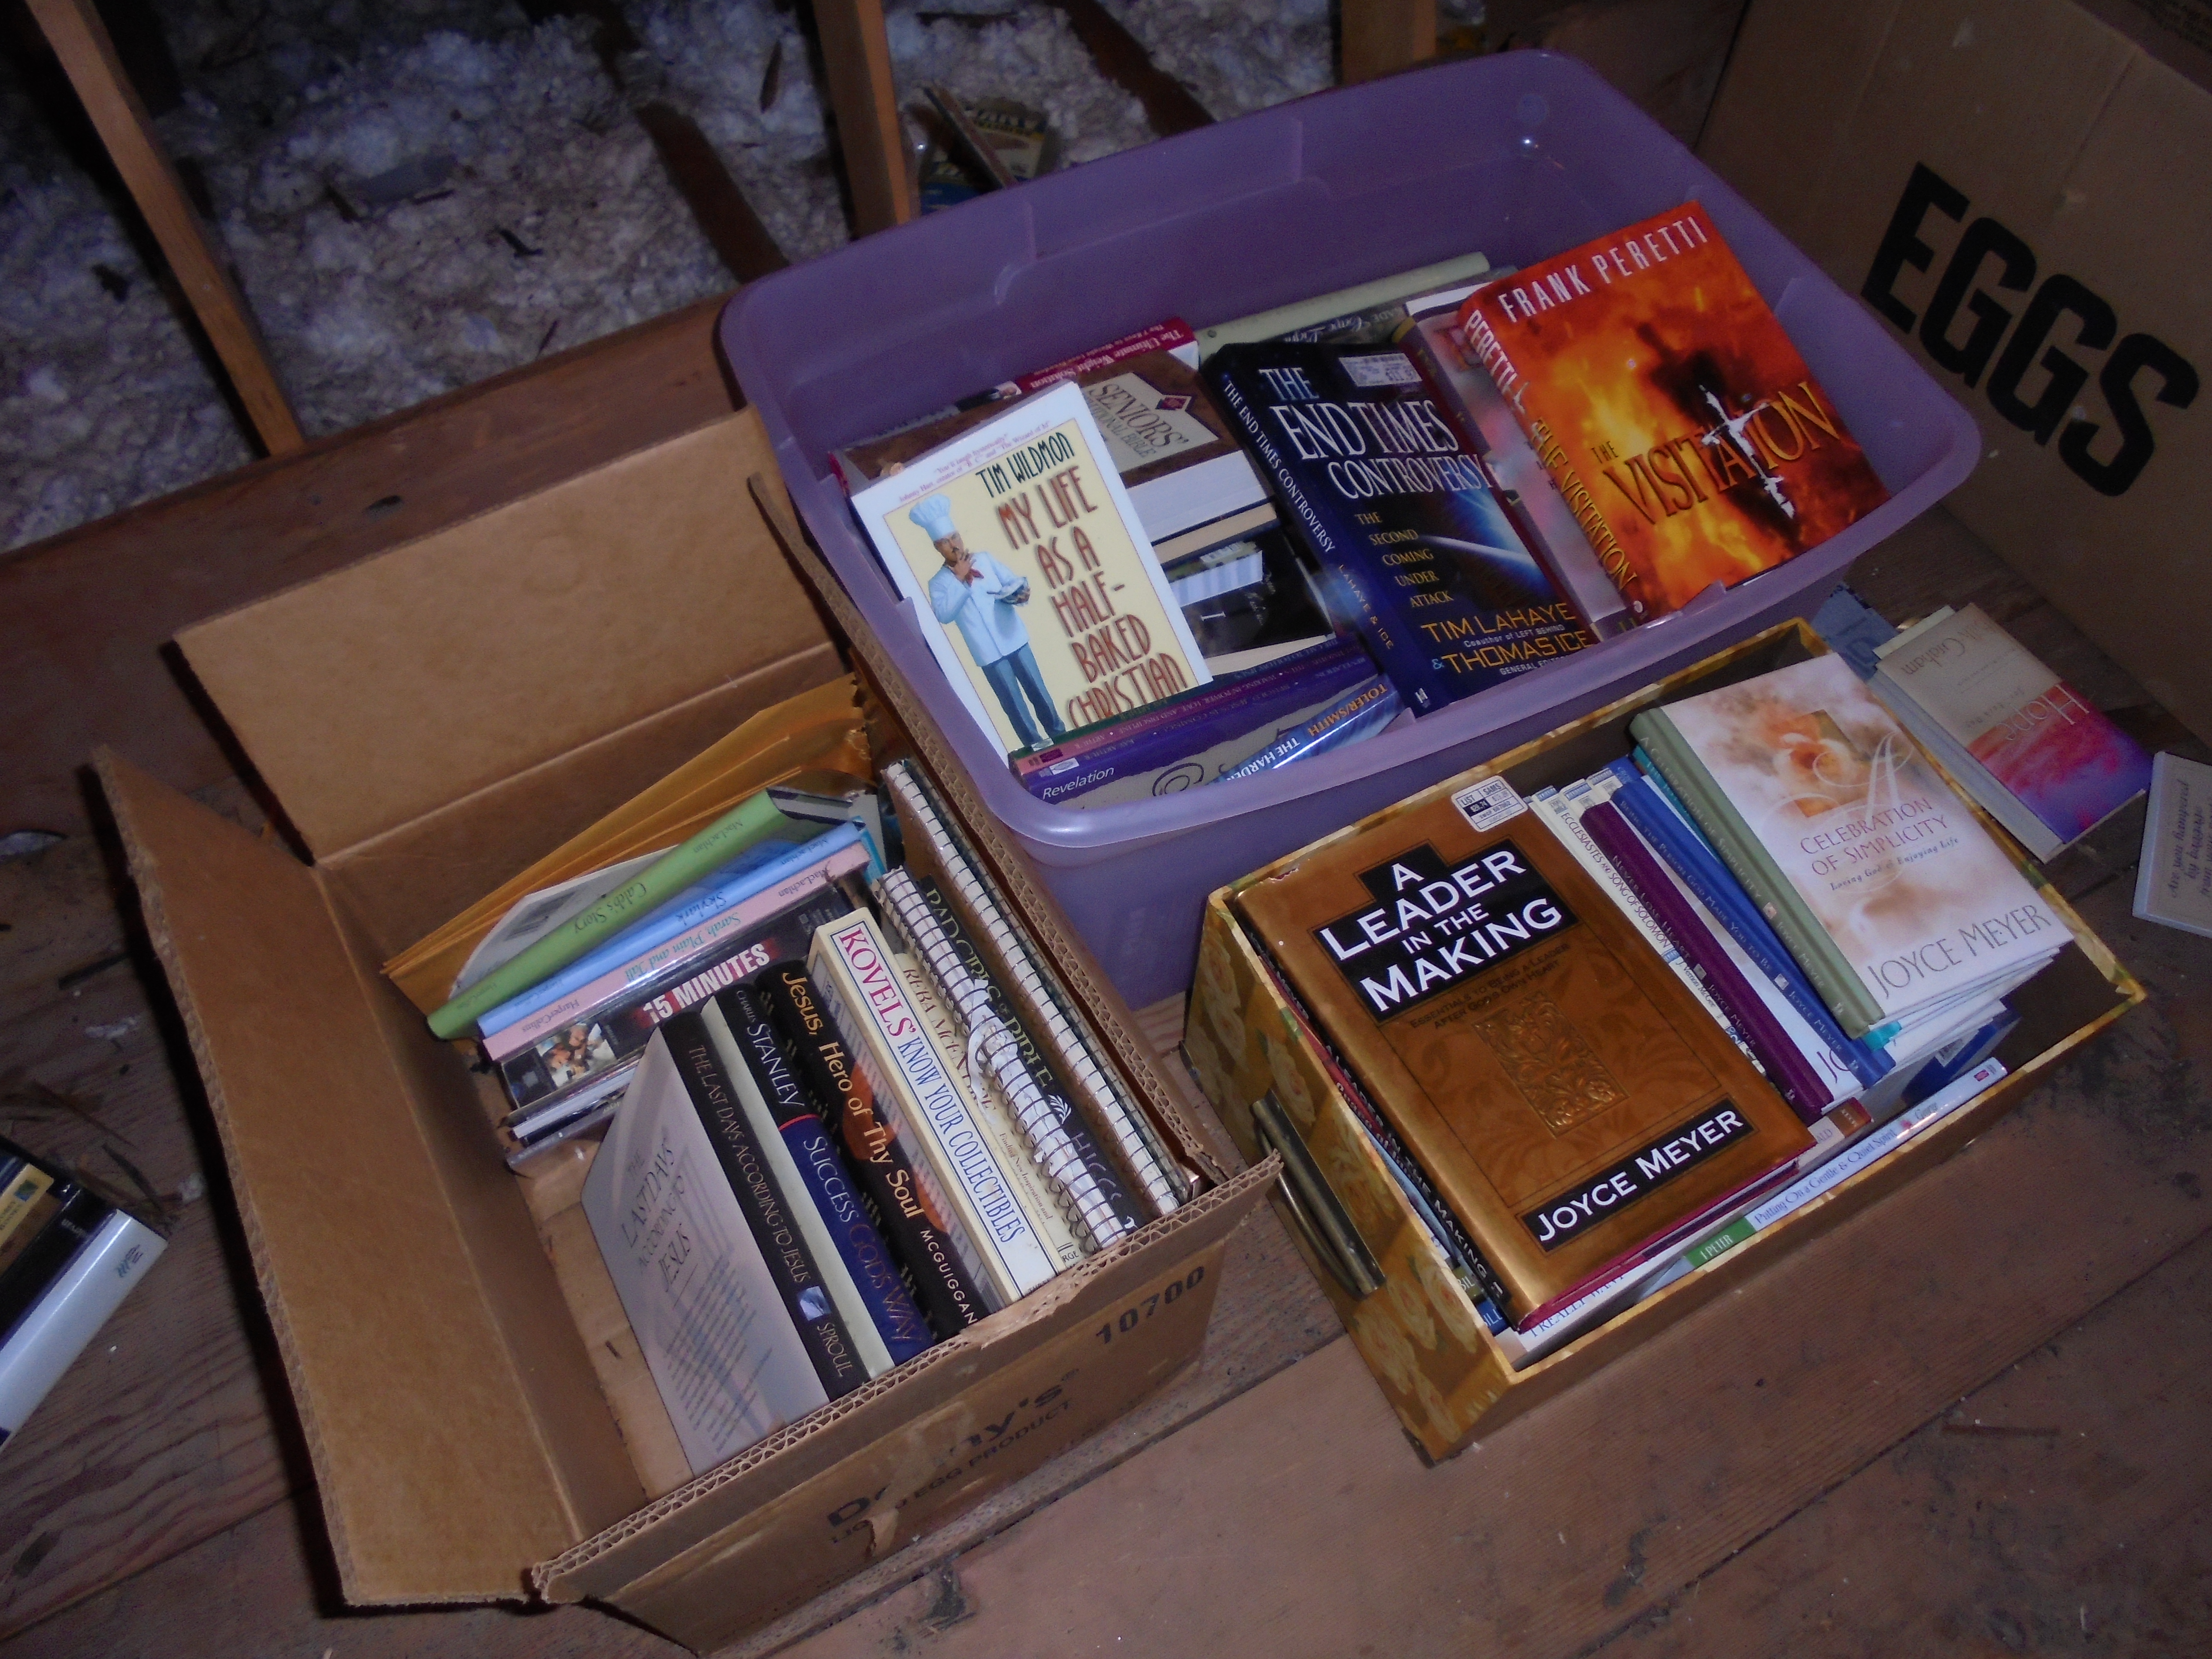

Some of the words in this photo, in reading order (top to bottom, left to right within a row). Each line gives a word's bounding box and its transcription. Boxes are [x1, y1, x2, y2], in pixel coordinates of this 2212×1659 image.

[1498, 265, 1590, 323] FRANK
[1592, 216, 1707, 284] PERETTI
[1114, 337, 1160, 357] Ultimate
[1161, 330, 1184, 340] The
[1464, 310, 1518, 394] PERETTI
[1861, 161, 2200, 497] EGGS
[1031, 369, 1076, 388] Solution
[1078, 355, 1115, 372] Weight
[1258, 367, 1319, 401] THE
[1121, 433, 1157, 458] BIBLE
[1270, 402, 1366, 459] END
[1347, 400, 1458, 453] TIMES
[1591, 441, 1620, 465] THE
[1603, 381, 1840, 525] VISITATION
[976, 468, 1012, 498] TIM
[1006, 432, 1075, 483] WILDMON
[1328, 454, 1493, 499] CONTROVERSY
[996, 493, 1041, 549] MY
[1038, 466, 1097, 528] LIFE
[1223, 381, 1241, 408] THE
[1240, 405, 1259, 434] END
[1256, 431, 1282, 469] TIMES
[1279, 468, 1335, 553] CONTROVERSY
[1338, 564, 1371, 613] LAHAYE
[1378, 628, 1393, 649] ICE
[1355, 512, 1382, 526] THE
[1561, 471, 1638, 590] VISITATION
[1037, 537, 1074, 589] AS
[1073, 527, 1100, 571] A
[1369, 529, 1419, 546] SECOND
[1382, 548, 1434, 566] COMING
[1394, 570, 1439, 586] UNDER
[1410, 590, 1454, 608] ATTACK
[1051, 571, 1125, 637] HALF-
[1421, 620, 1476, 642] TIM
[1474, 603, 1577, 633] LAHAYE
[1072, 615, 1151, 683] BAKED
[1431, 658, 1444, 670] &
[1441, 636, 1554, 673] THOMAS
[1556, 631, 1594, 649] ICE
[1464, 635, 1502, 648] Coauthor
[1505, 632, 1513, 640] of
[1514, 628, 1535, 639] LEFT
[1537, 624, 1565, 635] BEHIND
[1068, 653, 1188, 728] CHRISTIAN
[1499, 663, 1537, 675] GENERAL
[1308, 684, 1388, 736] TOLER/SMITH
[1996, 684, 2089, 740] Hope
[1279, 737, 1300, 757] THE
[1042, 766, 1115, 800] Revelation
[1461, 795, 1475, 805] LIST
[1483, 783, 1502, 795] SAMS
[693, 818, 744, 854] MacLachlan
[1799, 796, 1934, 855] CELEBRATION
[1811, 855, 1838, 876] OF
[1845, 814, 1949, 865] SIMPLICITY
[778, 867, 830, 898] MacLachlan
[1392, 863, 1425, 891] A
[1830, 872, 1863, 892] Loving
[1864, 864, 1881, 878] God
[1896, 847, 1937, 867] Enjoying
[1941, 836, 1959, 849] Life
[573, 909, 607, 934] Story
[606, 882, 647, 914] Caleb's
[675, 892, 727, 925] Skylark
[1320, 850, 1527, 961] LEADER
[1561, 812, 1603, 863] ECCLESIASTES
[1601, 862, 1611, 873] AND
[1608, 872, 1629, 896] SONG
[1627, 895, 1638, 910] OF
[1634, 904, 1671, 948] SOLOMON
[1682, 964, 1700, 988] Vernon
[1698, 986, 1717, 1008] McGee
[672, 935, 705, 955] Plain
[706, 912, 741, 938] Sarah,
[1401, 931, 1432, 954] IN
[1434, 903, 1490, 936] THE
[625, 963, 645, 982] Tall
[648, 951, 670, 972] and
[1359, 897, 1562, 1012] MAKING
[1867, 938, 1962, 999] JOYCE
[1958, 903, 2052, 956] MEYER
[643, 990, 675, 1025] 15
[673, 942, 770, 1011] MINUTES
[903, 968, 936, 1014] REBA
[1410, 994, 1472, 1028] ESSENTIALS
[1474, 987, 1487, 996] TO
[1489, 969, 1521, 988] BEING
[1529, 943, 1571, 967] LEADER
[1434, 1009, 1468, 1029] AFTER
[1502, 978, 1527, 994] OWN
[1527, 959, 1561, 981] HEART
[521, 999, 580, 1032] HarperCollins
[689, 1044, 709, 1073] THE
[747, 1023, 805, 1107] STANLEY
[702, 1070, 726, 1106] LAST
[838, 927, 917, 1038] KOVELS'
[896, 1036, 943, 1087] KNOW
[923, 1084, 964, 1135] YOUR
[948, 1130, 1027, 1243] COLLECTIBLES
[717, 1103, 741, 1142] DAYS
[783, 972, 824, 1038] Jesus,
[818, 1041, 853, 1093] Hero
[847, 1096, 873, 1117] of
[863, 1121, 893, 1165] Thy
[885, 1169, 925, 1219] Soul
[919, 1229, 979, 1327] MCGUIGGAN
[732, 1145, 787, 1227] ACCORDING
[999, 1133, 1015, 1158] Finding
[1022, 1173, 1042, 1207] Inspiration
[1042, 1208, 1053, 1219] and
[1538, 1170, 1638, 1242] JOYCE
[1634, 1109, 1744, 1181] MEYER
[1754, 1202, 1787, 1224] Putting
[1785, 1191, 1804, 1203] On
[1809, 1168, 1839, 1189] Gentle
[1839, 1162, 1847, 1170] &
[1847, 1143, 1873, 1163] Quiet
[1872, 1130, 1896, 1148] Spirit
[773, 1226, 793, 1246] TO
[803, 1135, 860, 1224] SUCCESS
[881, 1286, 921, 1343] WAY
[1434, 1200, 1487, 1278] MAKING
[1705, 1234, 1734, 1256] PETER
[781, 1244, 812, 1284] JESUS
[1095, 1266, 1204, 1345] 10700
[817, 1323, 853, 1378] SPROUL
[915, 1465, 963, 1499] EGG
[969, 1400, 1073, 1468] PRODUCT
